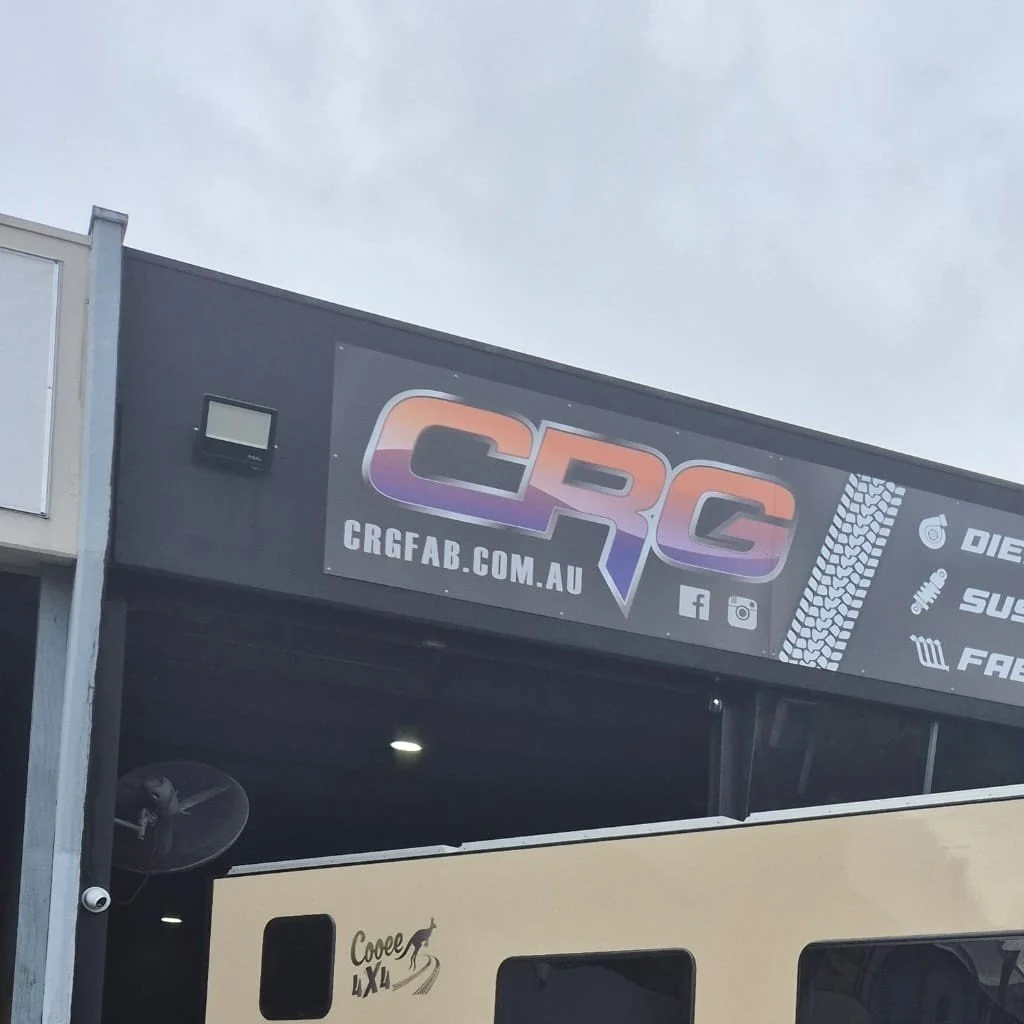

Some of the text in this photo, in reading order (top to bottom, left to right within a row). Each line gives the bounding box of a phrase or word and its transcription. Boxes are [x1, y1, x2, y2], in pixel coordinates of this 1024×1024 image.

[362, 389, 796, 619] CRG
[343, 519, 584, 595] CRGFAB.COM.AU
[350, 930, 404, 966] Cooee
